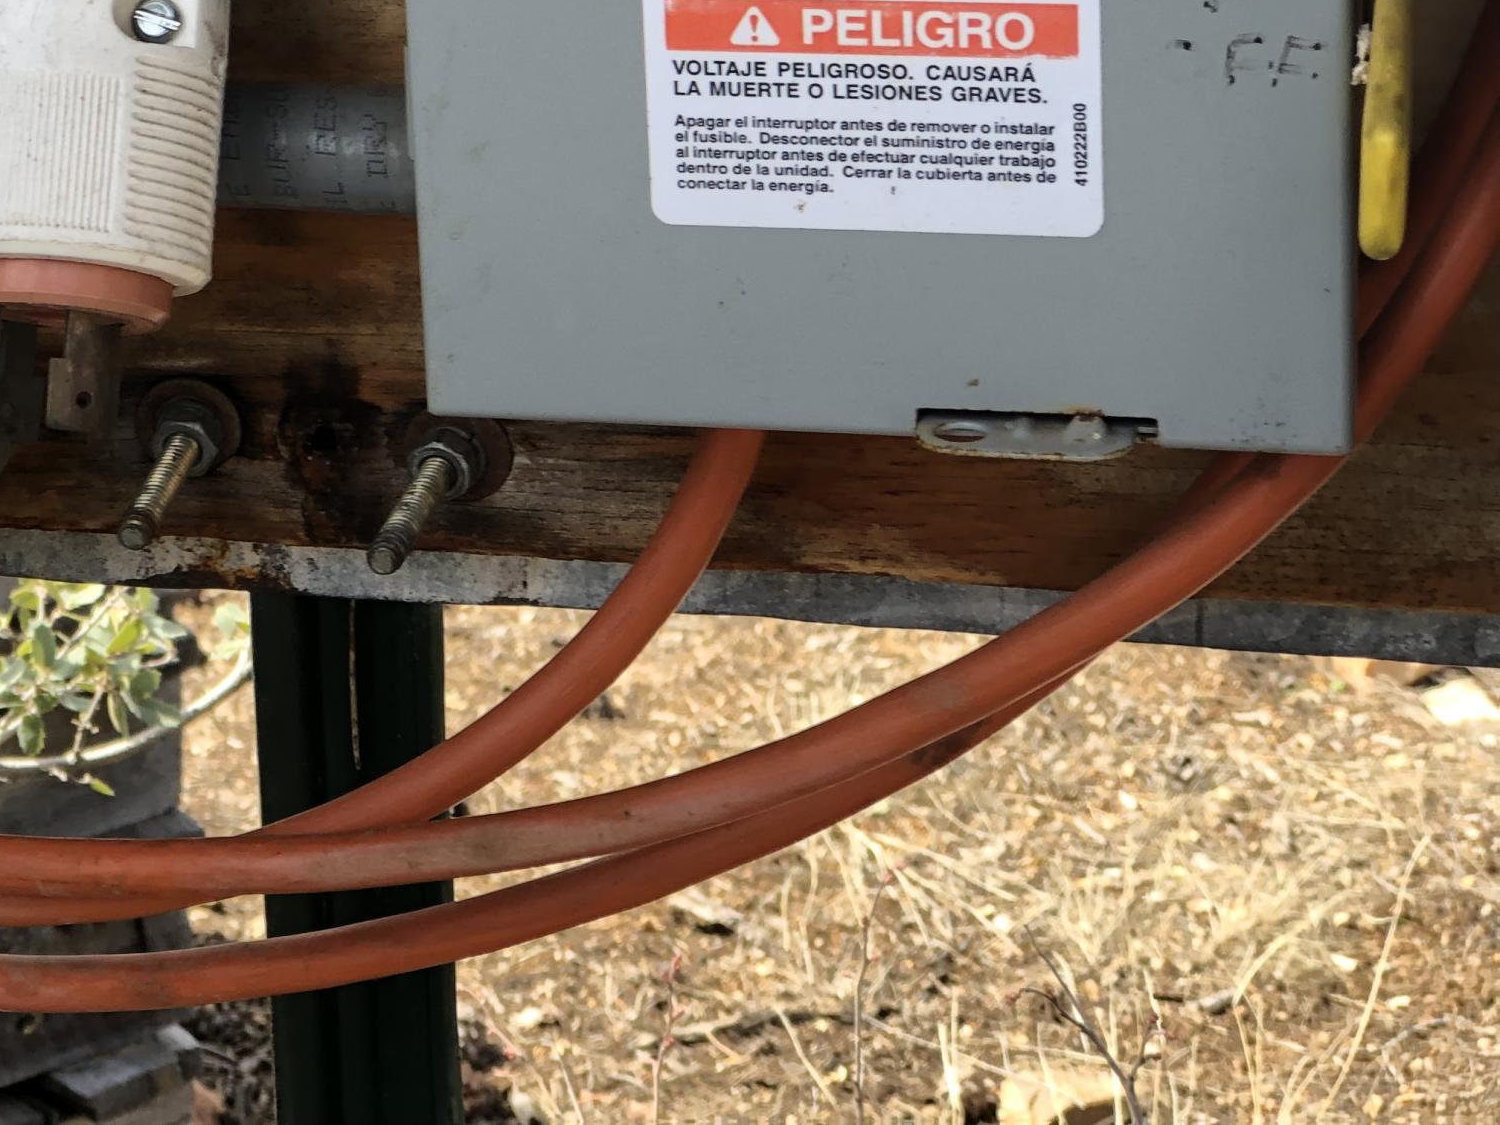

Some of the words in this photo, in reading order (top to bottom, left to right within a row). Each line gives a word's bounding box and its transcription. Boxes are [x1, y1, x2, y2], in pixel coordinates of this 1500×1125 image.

[801, 8, 1034, 50] PELIGRO
[672, 60, 766, 76] VOLTAJE
[778, 62, 913, 79] PELIGROSO.
[926, 63, 1035, 82] CAUSARÁ
[674, 80, 700, 95] LA
[709, 81, 799, 98] MUERTE
[808, 83, 823, 98] O
[833, 84, 941, 101] LESIONES
[951, 86, 1047, 103] GRAVES.
[675, 115, 731, 132] Apagar
[735, 117, 747, 127] el
[752, 117, 836, 133] interruptor
[840, 119, 883, 131] antes
[887, 119, 906, 131] de
[910, 122, 977, 133] remover
[980, 124, 991, 134] o
[994, 122, 1054, 135] instalar
[675, 130, 688, 142] el
[692, 130, 751, 143] fusible.
[863, 135, 877, 146] el
[881, 136, 967, 149] suministro
[971, 138, 990, 149] de
[1073, 103, 1088, 187] 410222B00
[677, 179, 747, 190] conectar
[751, 179, 764, 190] la
